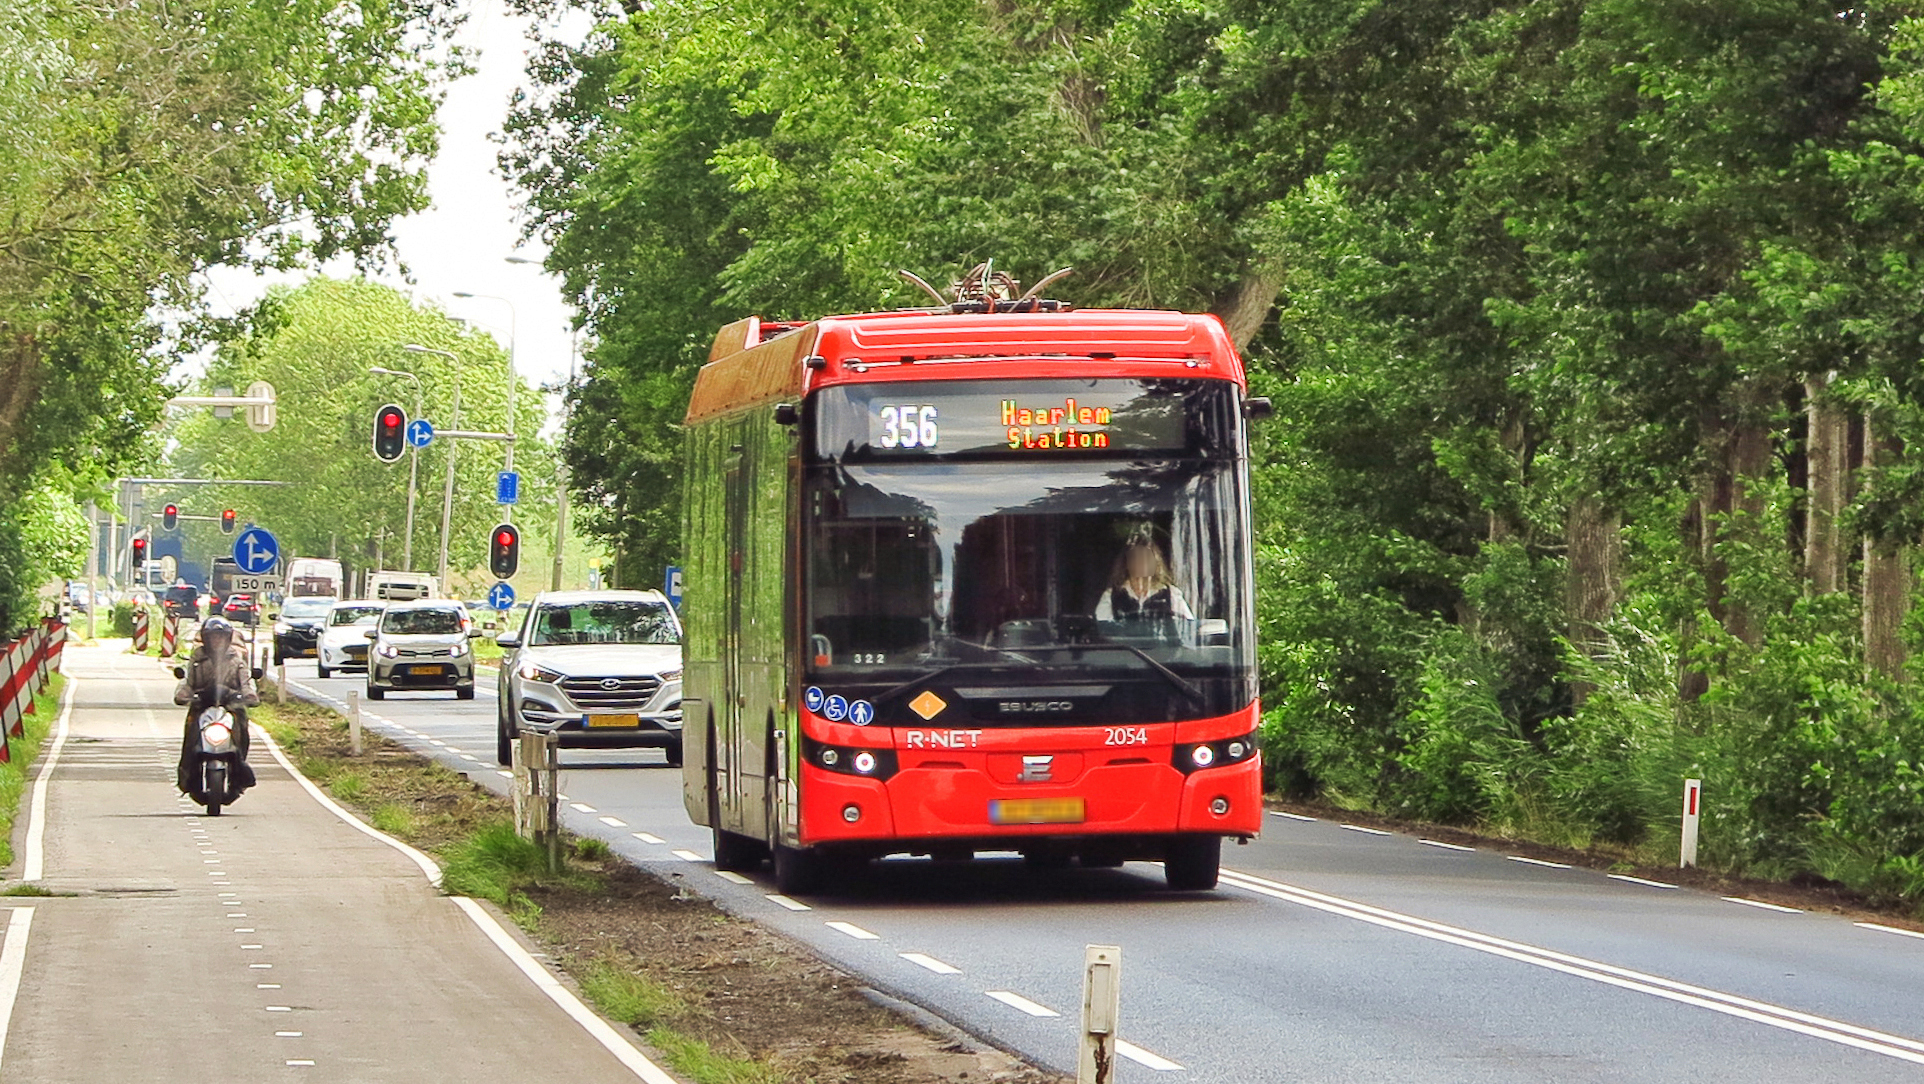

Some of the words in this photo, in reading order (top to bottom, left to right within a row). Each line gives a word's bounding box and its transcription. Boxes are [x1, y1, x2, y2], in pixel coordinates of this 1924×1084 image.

[1001, 398, 1112, 426] Haarlem
[880, 404, 938, 449] 356
[1007, 427, 1109, 449] Station
[236, 578, 259, 590] 150
[264, 581, 276, 590] m
[1105, 727, 1147, 746] 2054
